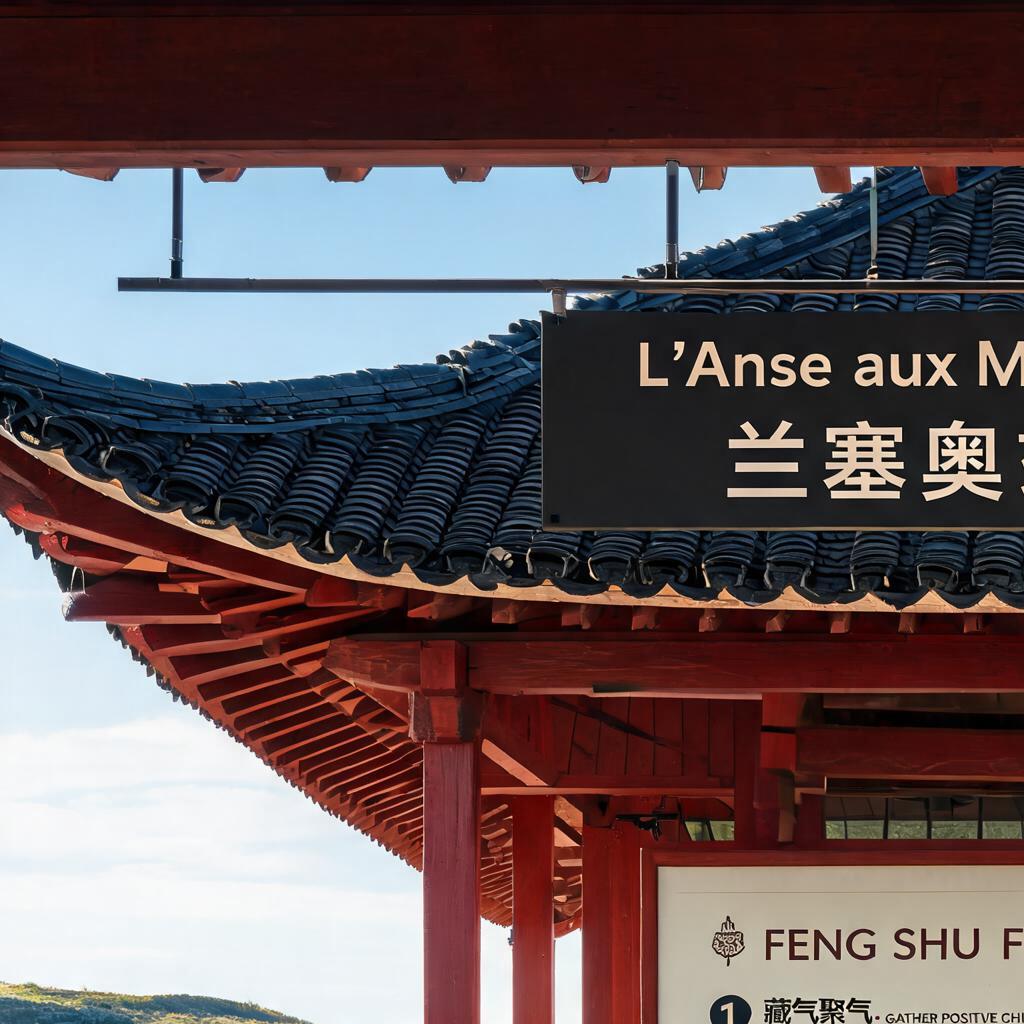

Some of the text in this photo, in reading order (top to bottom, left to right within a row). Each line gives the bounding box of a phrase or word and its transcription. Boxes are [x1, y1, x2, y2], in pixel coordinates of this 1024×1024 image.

[854, 353, 958, 388] aux
[765, 929, 876, 960] FENG
[894, 928, 980, 960] SHU
[764, 997, 872, 1024] 藏气聚气
[885, 1012, 938, 1024] GATHER
[1001, 1012, 1024, 1024] CHI
